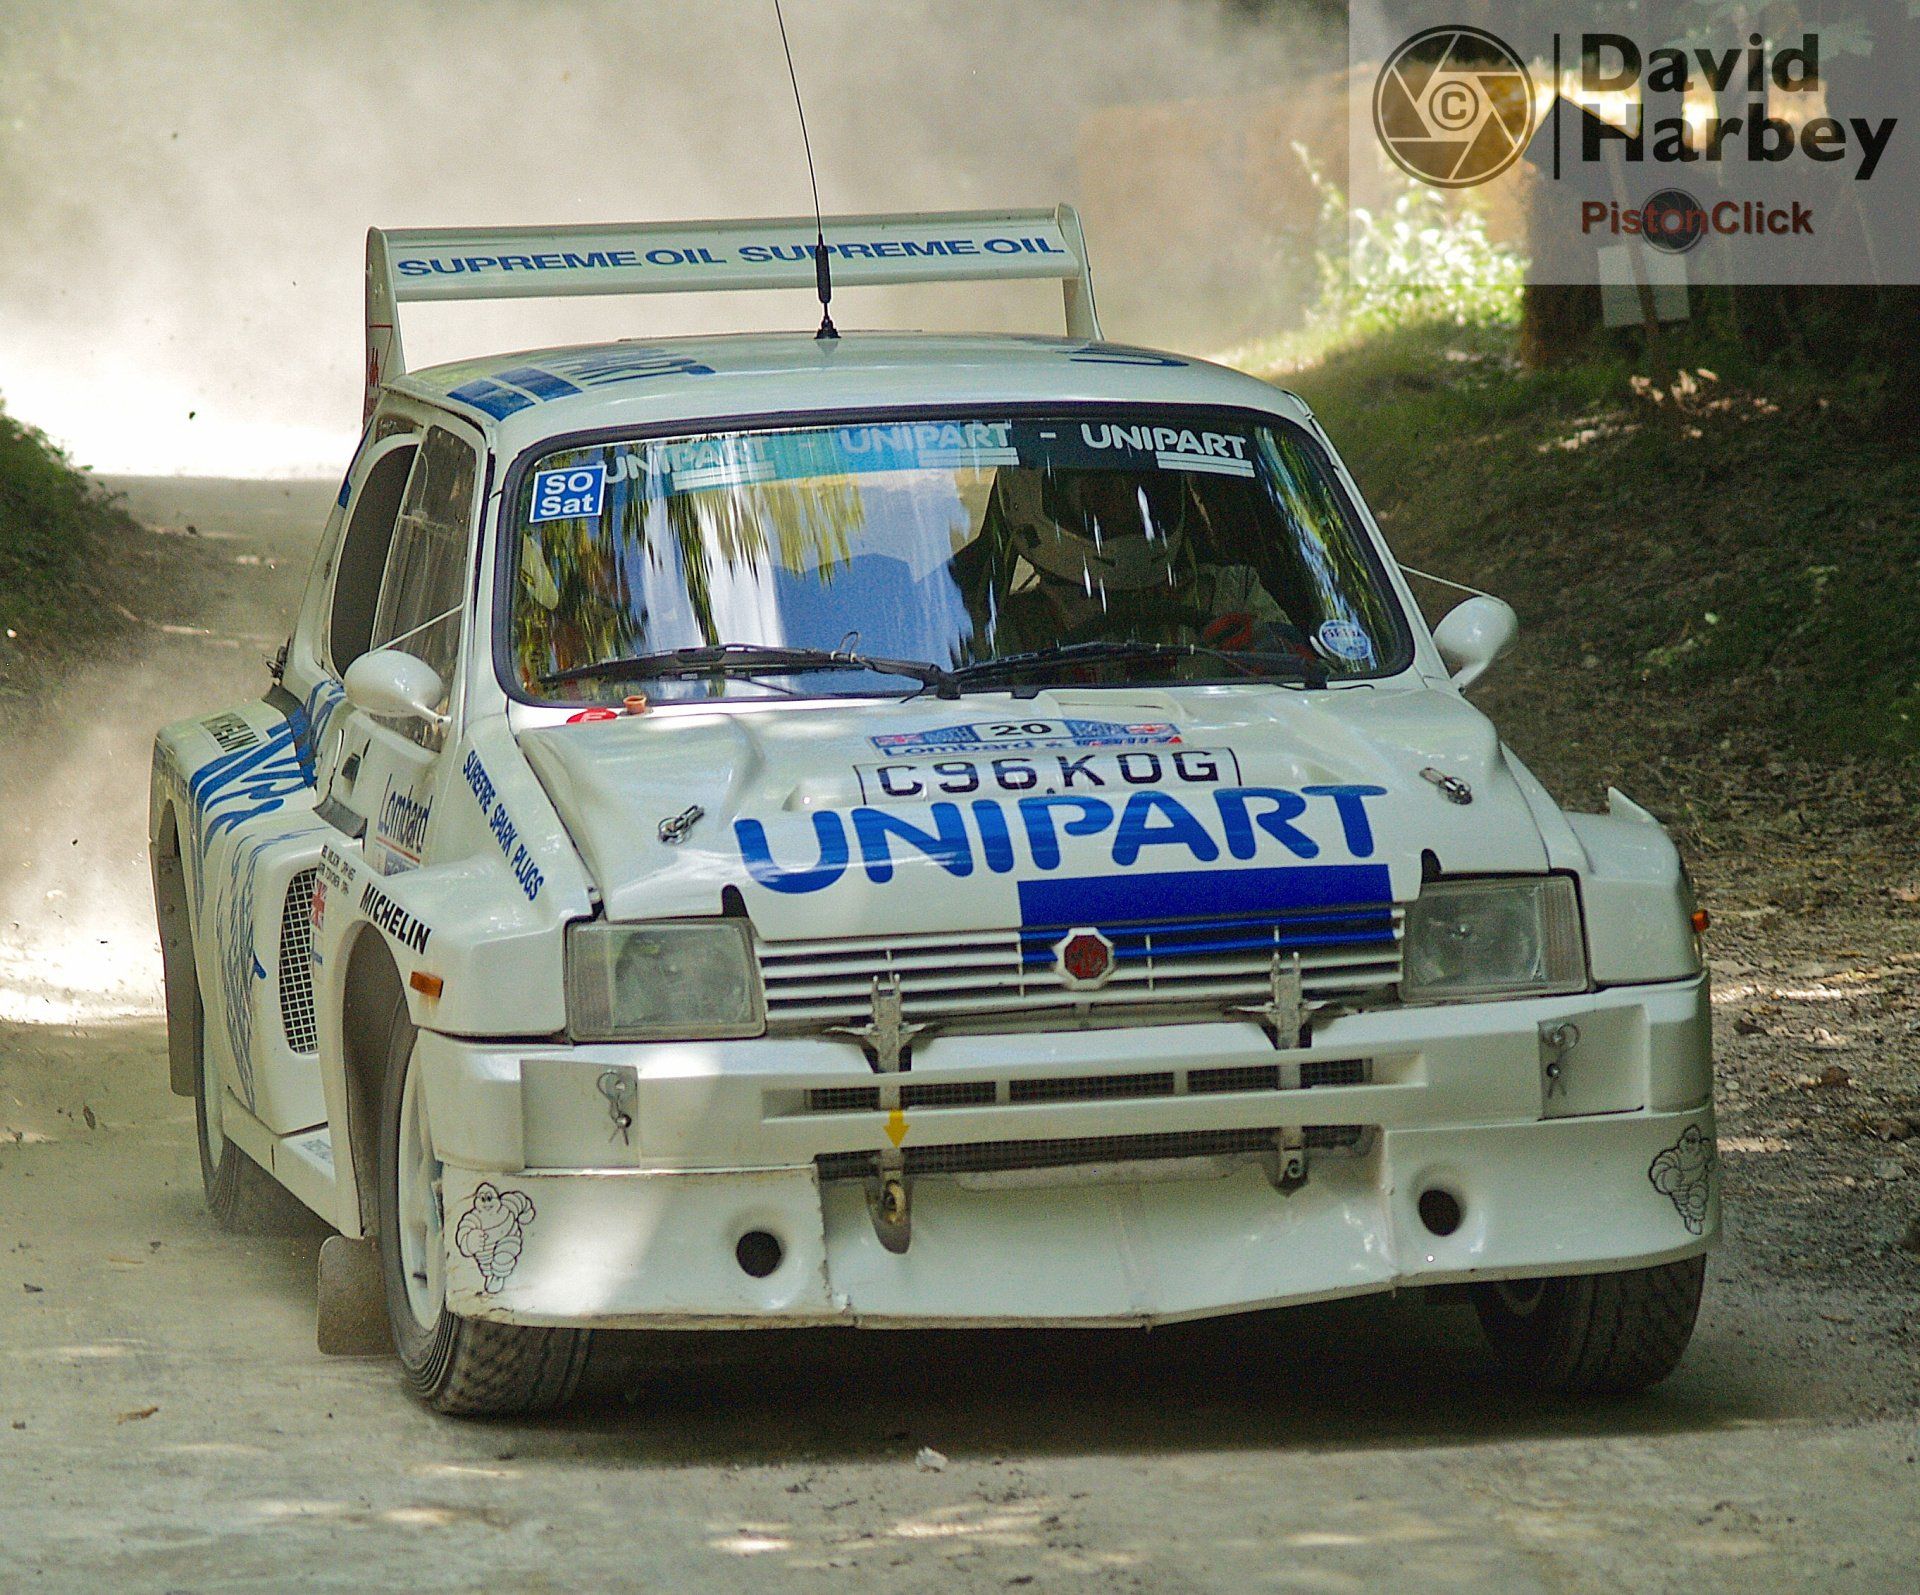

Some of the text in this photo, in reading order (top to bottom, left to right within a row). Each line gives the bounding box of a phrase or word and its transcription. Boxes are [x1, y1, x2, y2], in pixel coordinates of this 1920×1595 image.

[398, 238, 1064, 276] SUPREME OIL SUPREME OIL
[840, 423, 1011, 453] UNIPART
[1081, 423, 1246, 459] UNIPART
[544, 472, 594, 496] SO
[539, 494, 594, 517] Sat
[990, 723, 1052, 736] 20
[877, 750, 1220, 797] C96 KOG
[378, 773, 434, 853] Lombard
[463, 750, 545, 901] SUREFIRE SPARK PLUGS
[735, 785, 1387, 893] UNIPART
[360, 882, 432, 955] MICHELIN
